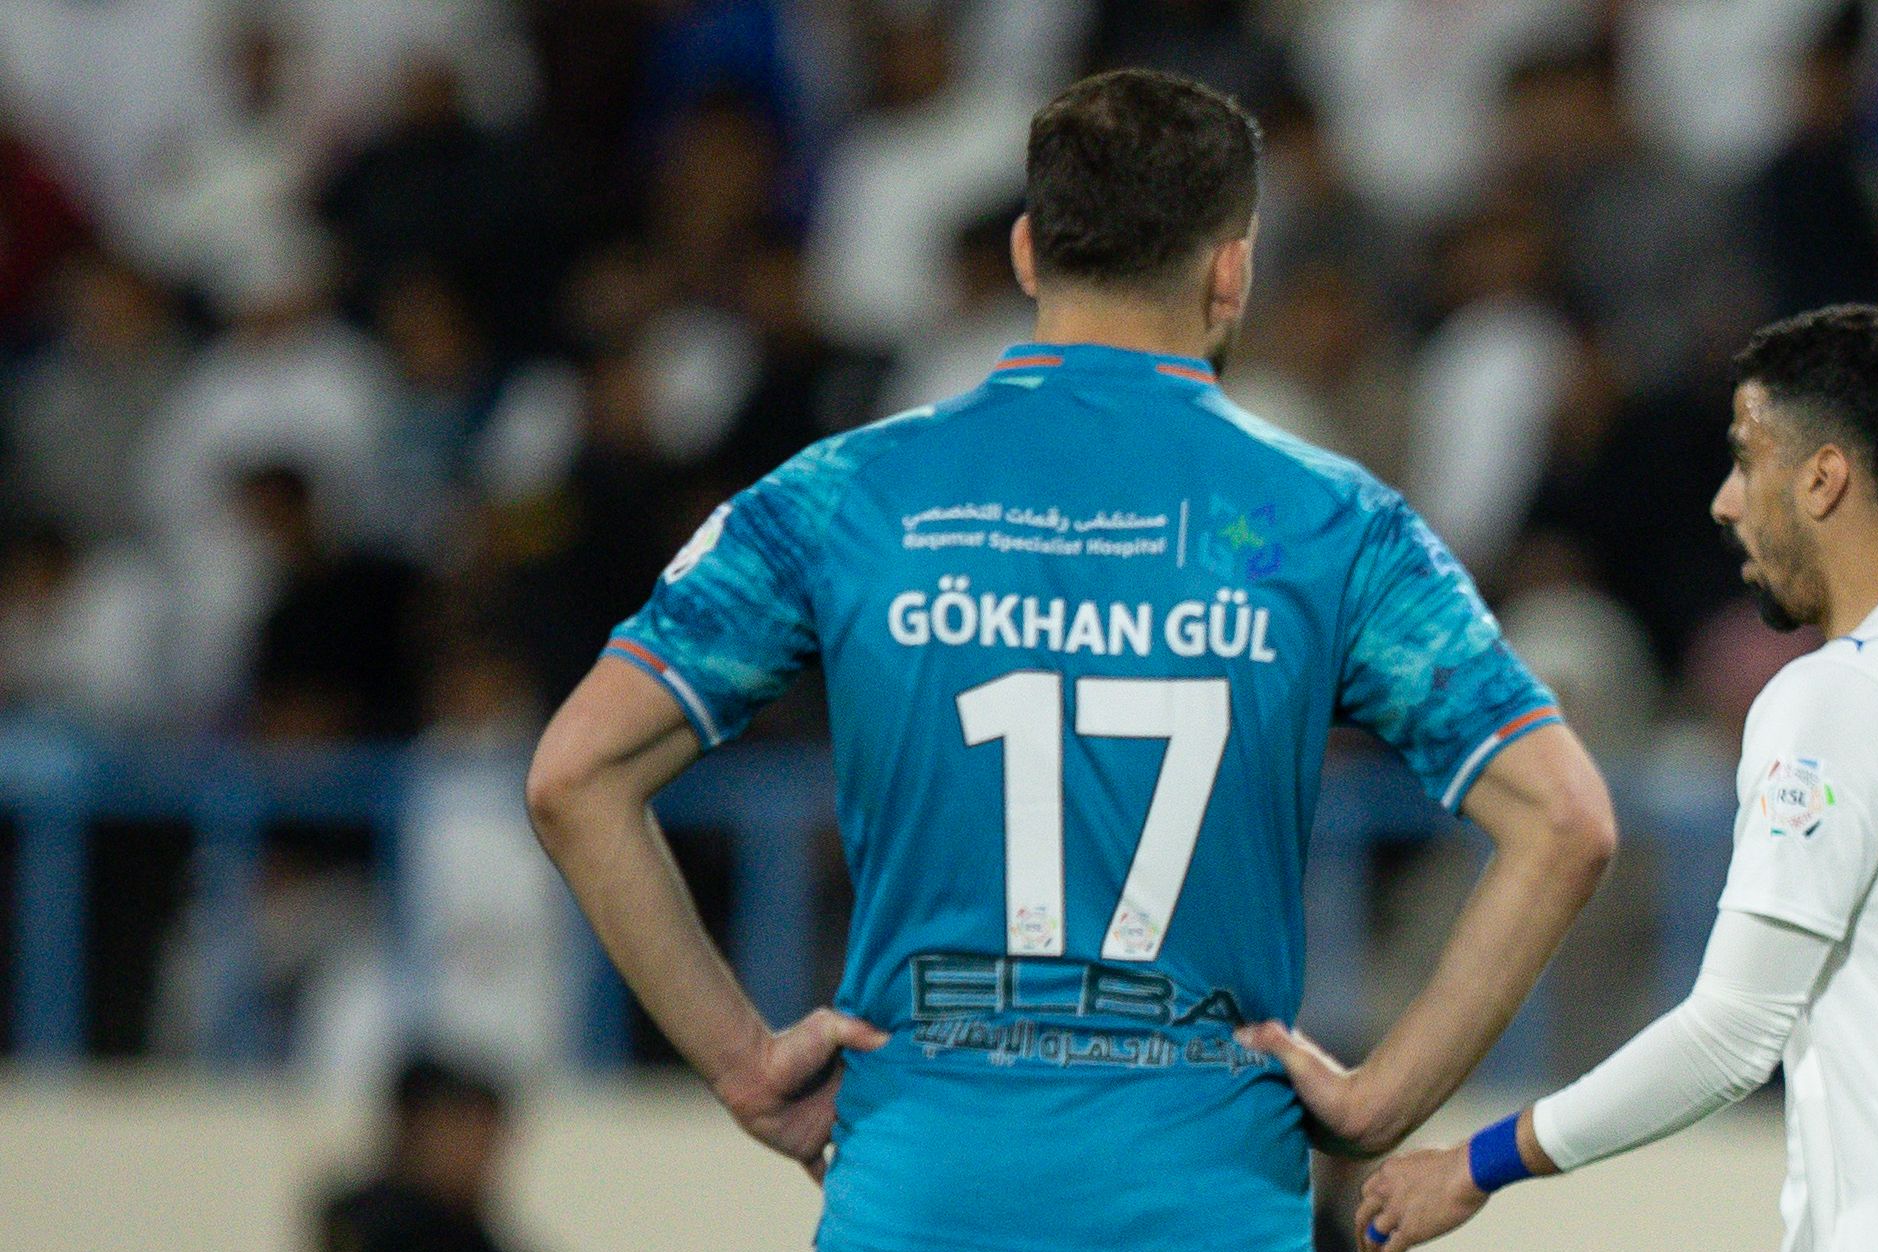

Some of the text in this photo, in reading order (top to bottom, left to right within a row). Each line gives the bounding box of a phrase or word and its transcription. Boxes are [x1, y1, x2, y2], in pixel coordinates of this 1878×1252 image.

[888, 574, 1276, 662] GÖKHAN GÜL
[956, 669, 1232, 961] 17
